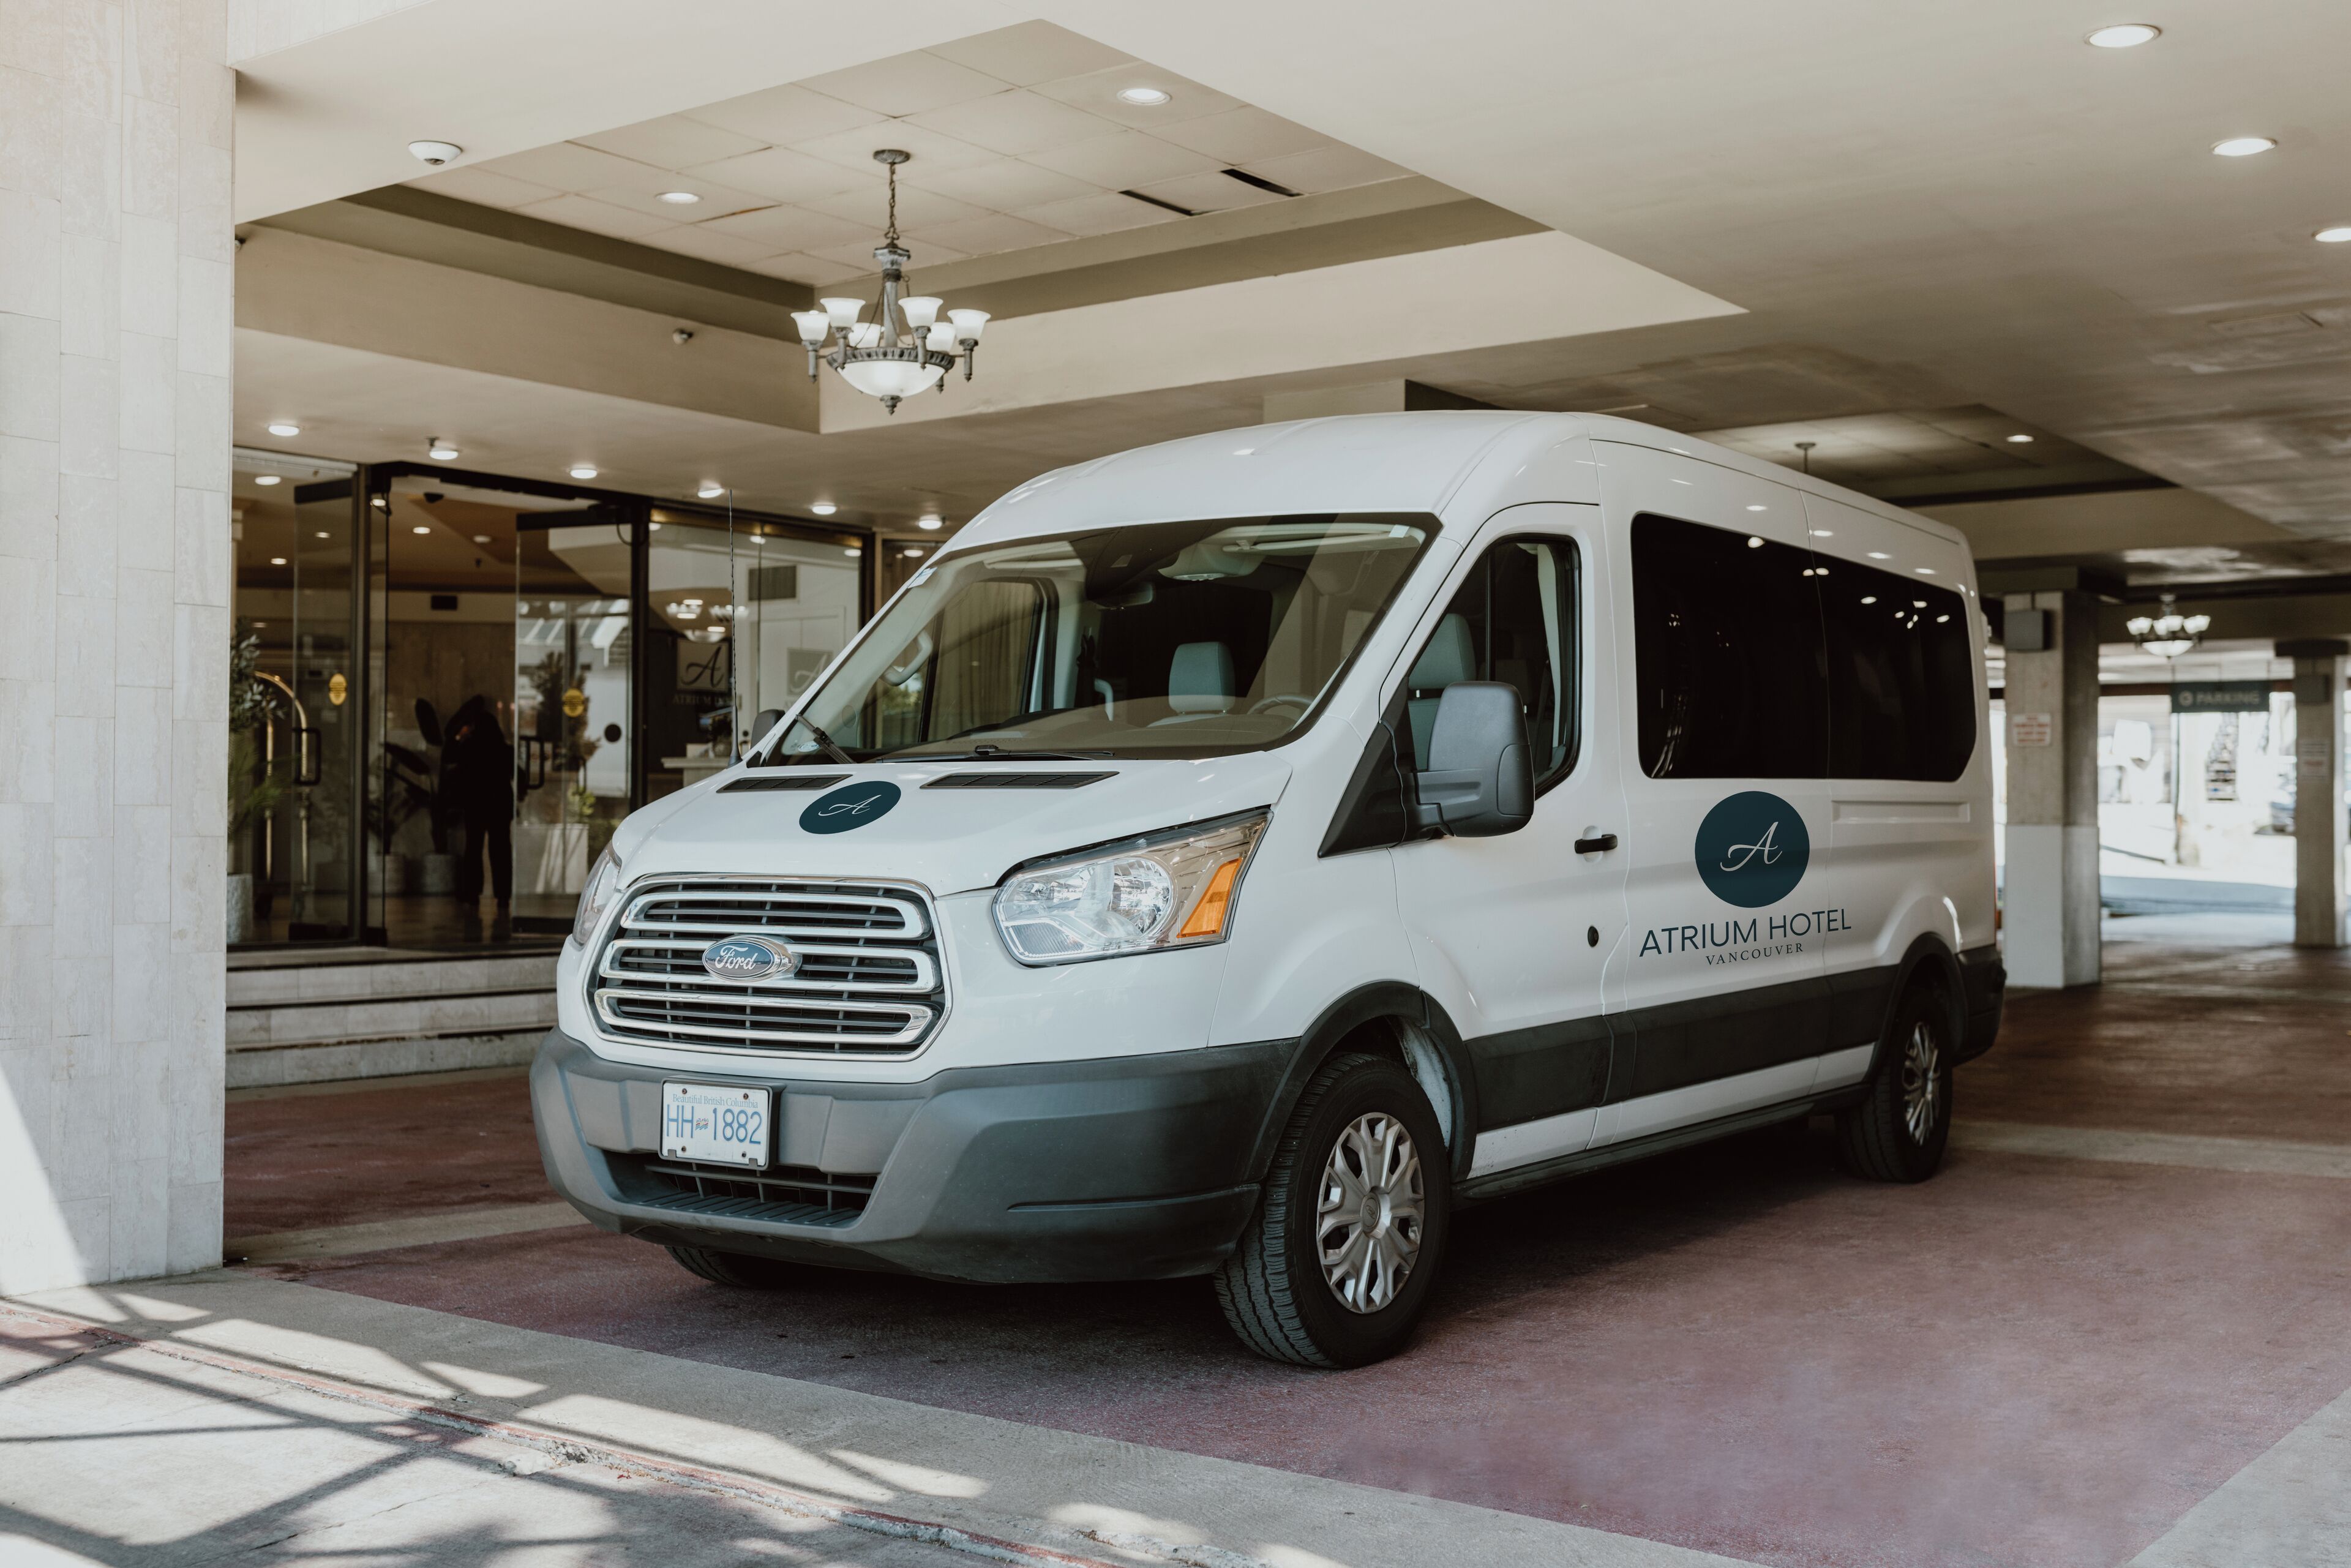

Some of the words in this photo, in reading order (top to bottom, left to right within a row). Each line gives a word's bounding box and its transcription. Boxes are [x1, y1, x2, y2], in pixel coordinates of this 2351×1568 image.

[681, 646, 724, 688] A
[2197, 691, 2259, 705] PARKING
[818, 794, 882, 816] A
[1720, 822, 1782, 871] A
[1639, 918, 1757, 958] ATRIUM
[1769, 909, 1851, 939] HOTEL
[714, 945, 759, 970] Ford
[1706, 943, 1803, 966] VANCOUVER
[673, 1094, 702, 1105] Beautiful
[703, 1096, 725, 1107] British
[726, 1098, 759, 1109] Columbia
[667, 1104, 694, 1139] HH
[712, 1107, 762, 1145] 1882
